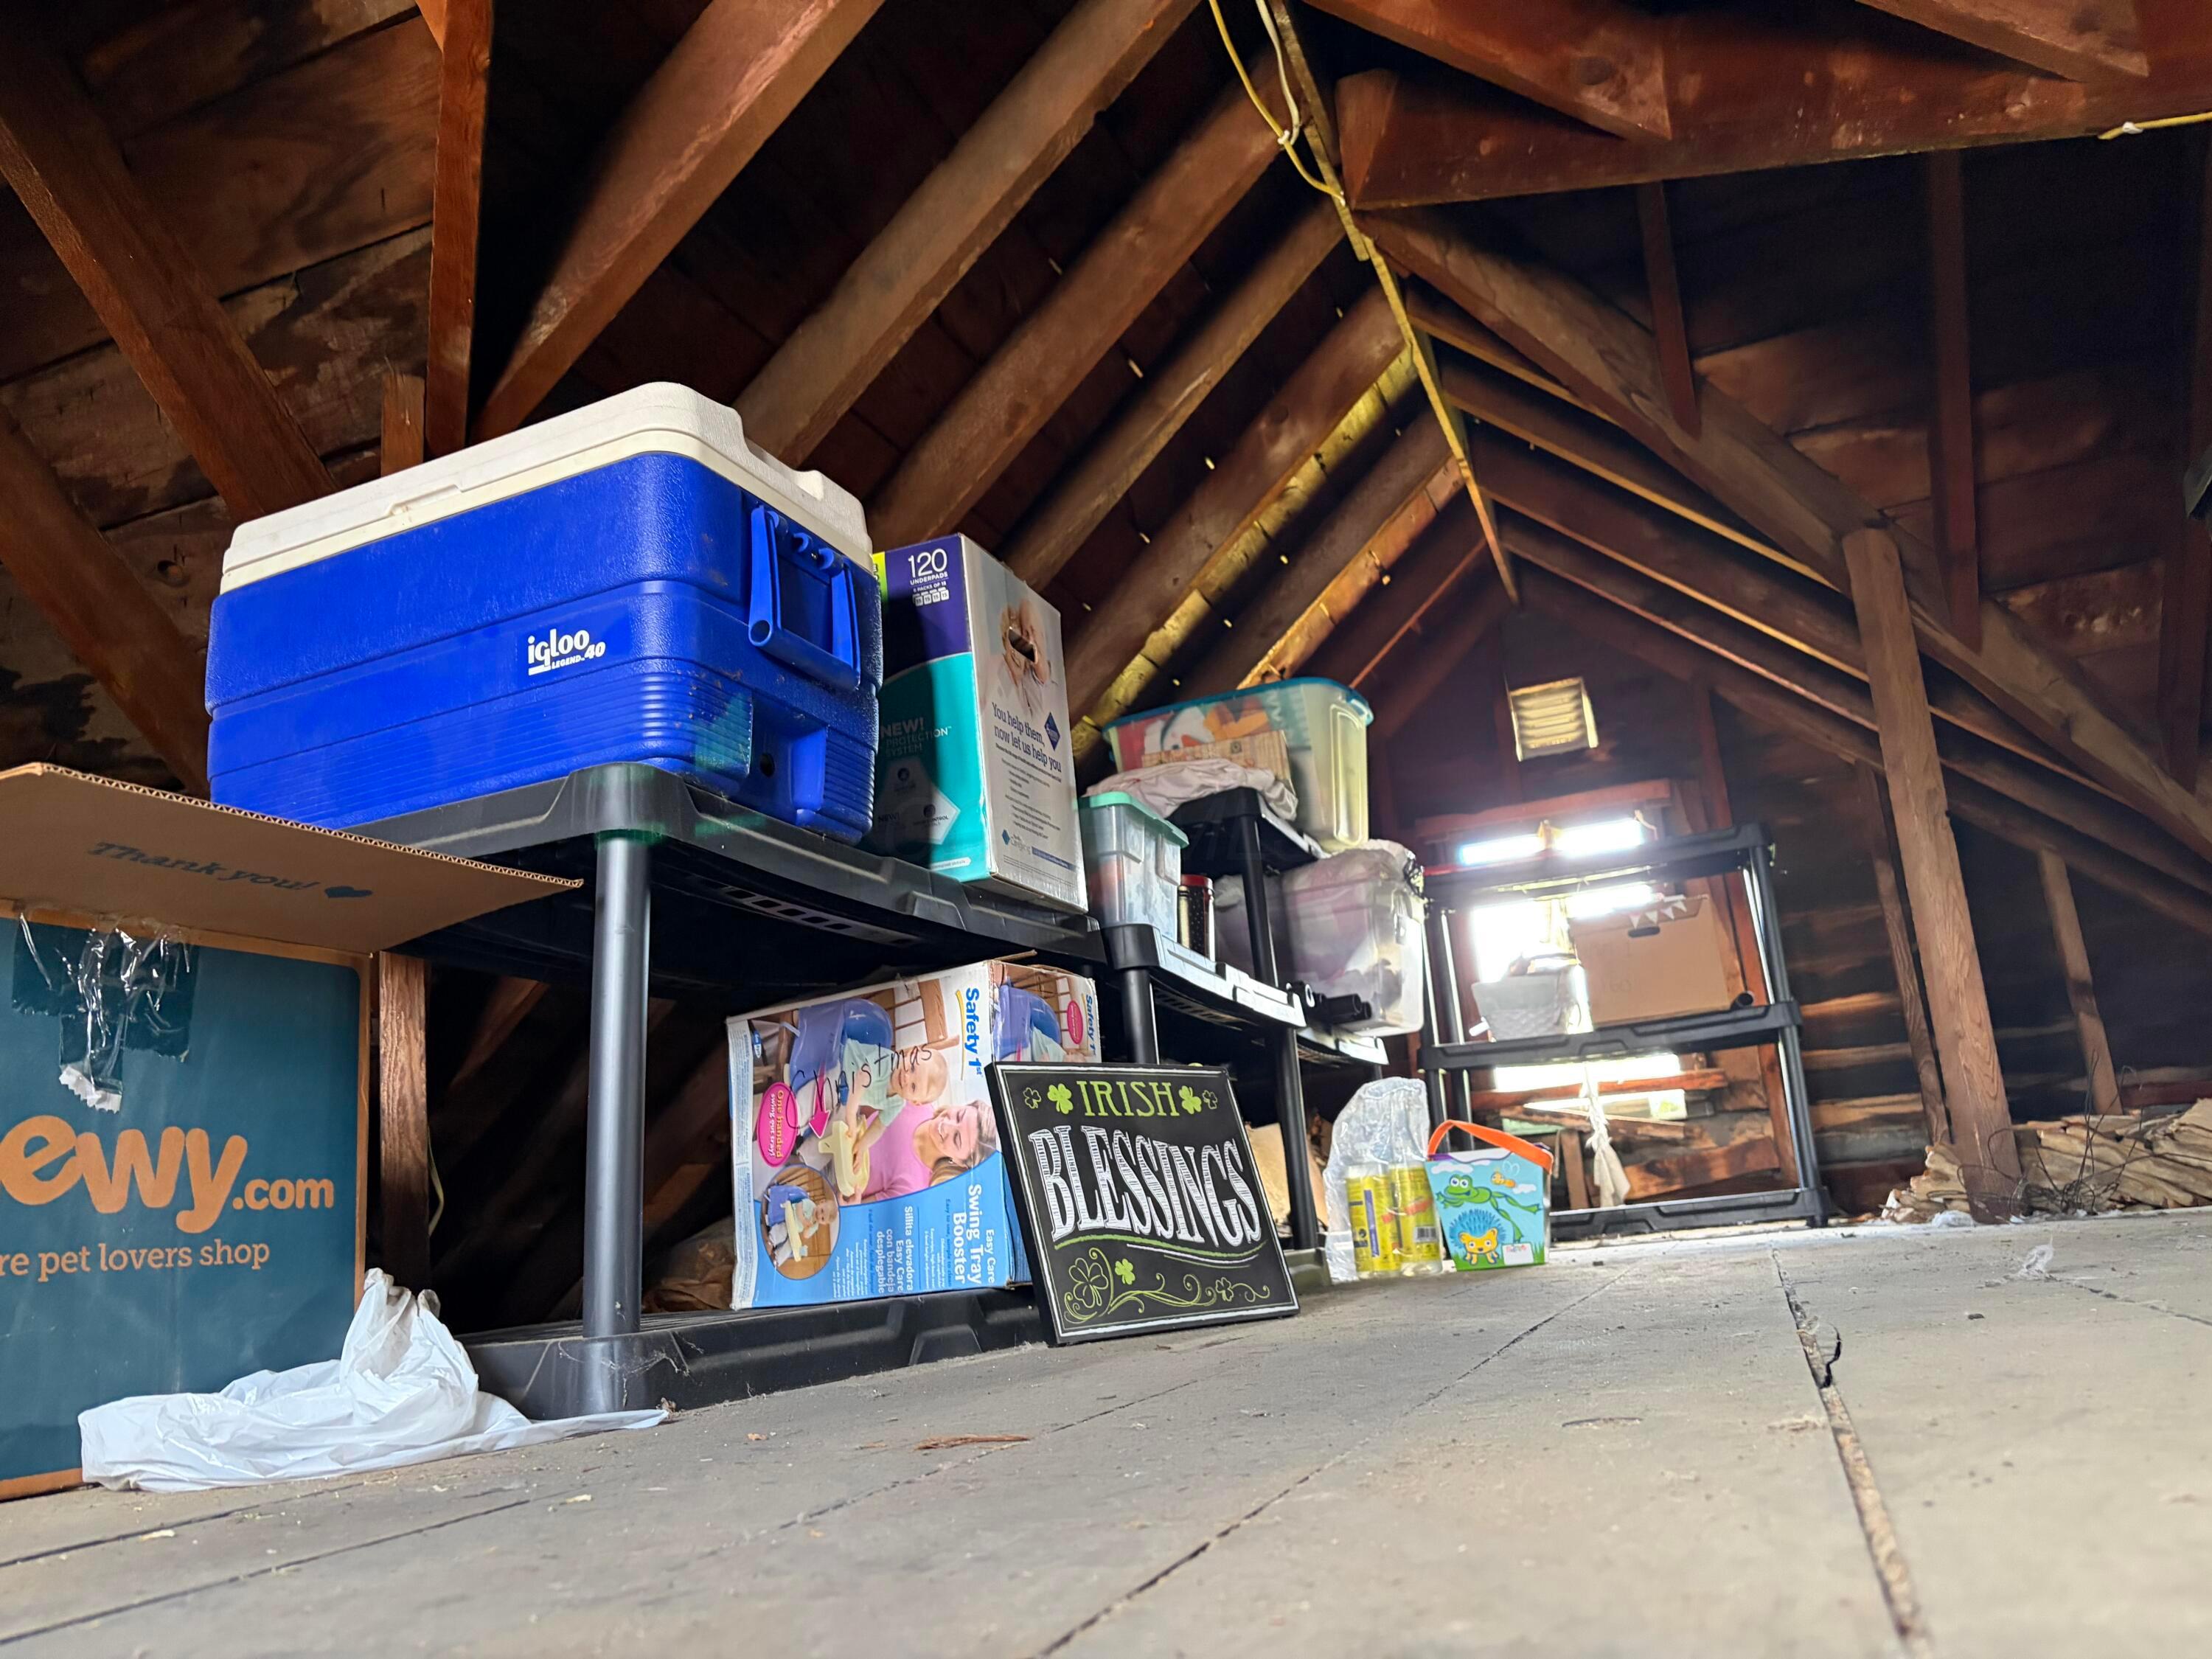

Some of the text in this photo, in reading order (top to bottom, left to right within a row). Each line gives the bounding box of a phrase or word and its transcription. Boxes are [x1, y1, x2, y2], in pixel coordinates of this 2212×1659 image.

[908, 548, 947, 578] 120
[910, 571, 948, 585] UNDERPADS
[528, 628, 590, 675] igloo
[552, 641, 606, 669] LEGEND 40
[880, 717, 925, 738] NEW!
[992, 702, 1006, 723] You
[1007, 710, 1024, 735] help
[1025, 722, 1046, 747] them,
[994, 726, 1010, 744] now
[1011, 731, 1022, 751] let
[1022, 742, 1032, 756] us
[1032, 743, 1048, 767] help
[1048, 756, 1062, 773] you
[88, 841, 321, 891] Thank you!
[964, 988, 980, 1054] Safety
[1086, 995, 1094, 1041] Safety
[1077, 1080, 1180, 1118] IRISH
[776, 1090, 785, 1158] One handed
[1028, 1125, 1262, 1248] BLESSINGS
[953, 1212, 967, 1284] Booster
[967, 1184, 984, 1284] Swing Tray
[984, 1229, 996, 1284] Easy Care
[38, 1245, 91, 1283] pet
[98, 1242, 193, 1272] lovers
[199, 1238, 271, 1270] shop
[875, 1231, 886, 1294] desplegable
[886, 1251, 895, 1293] bandeja
[894, 1239, 905, 1292] Easy Care
[905, 1239, 914, 1291] elevadora
